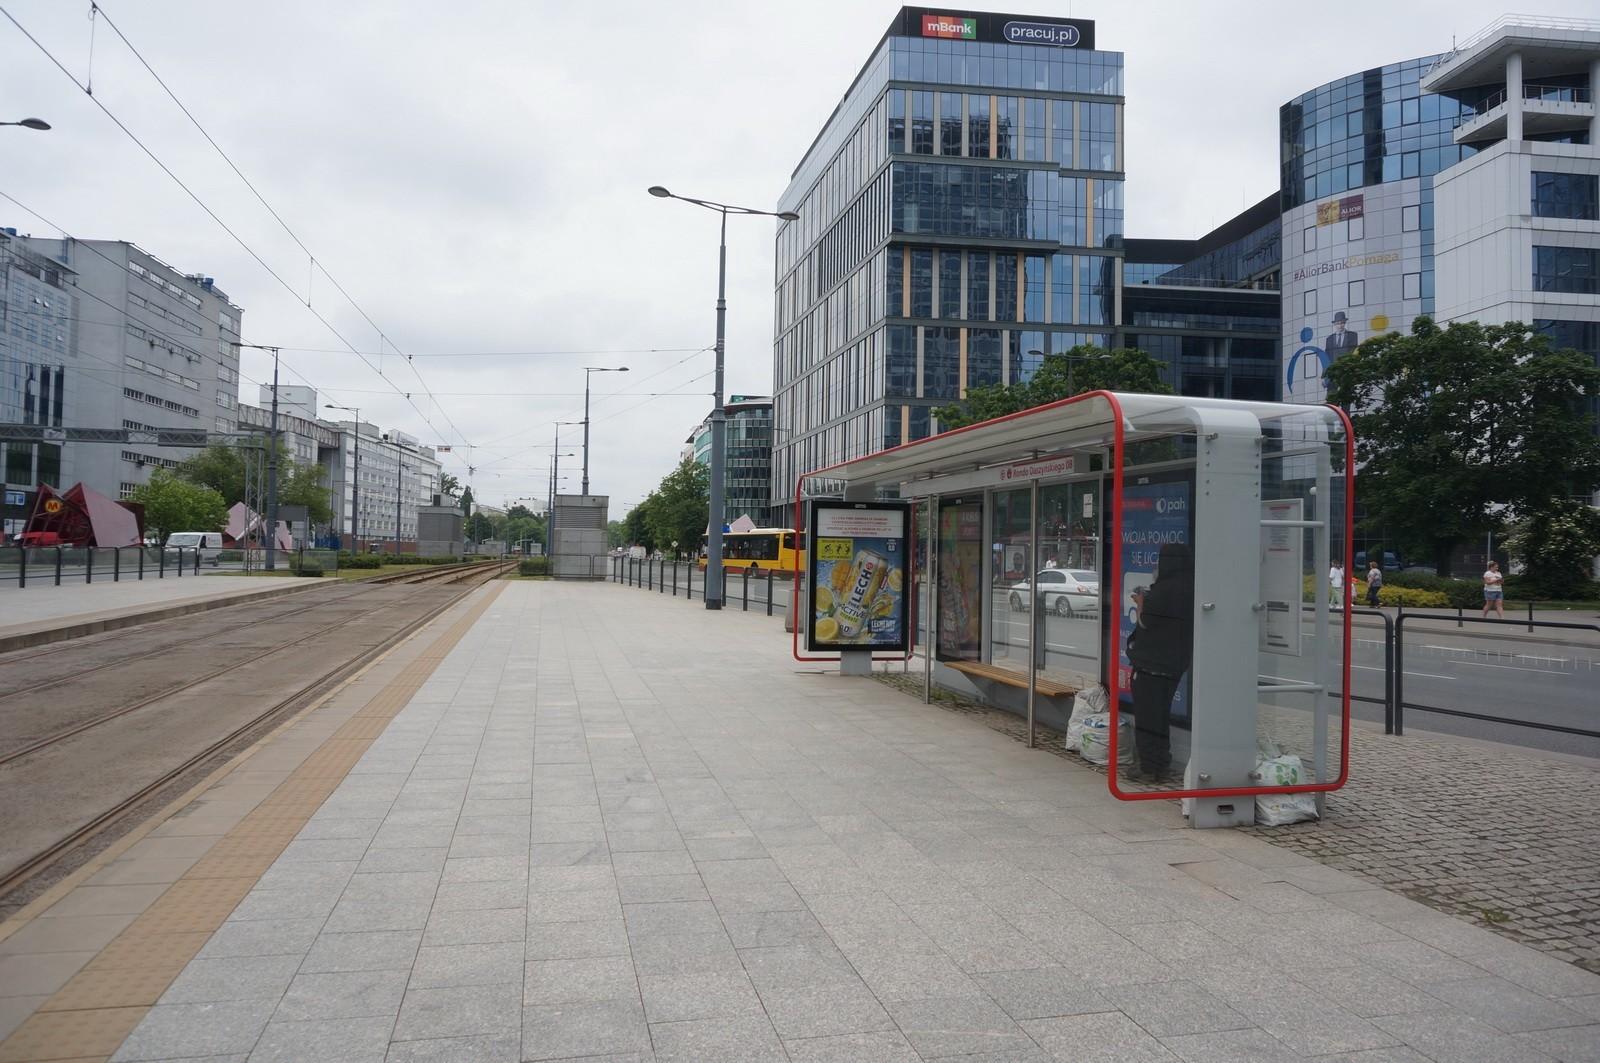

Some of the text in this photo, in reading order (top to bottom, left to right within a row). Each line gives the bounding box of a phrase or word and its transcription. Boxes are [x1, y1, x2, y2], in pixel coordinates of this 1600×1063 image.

[927, 22, 972, 34] mBank
[1011, 26, 1073, 43] pracuj.pl
[1012, 467, 1029, 478] Rondo
[1167, 496, 1185, 513] pah
[1120, 530, 1185, 545] WOJA POMOC
[1143, 551, 1160, 565] LIC
[851, 569, 873, 601] LECH
